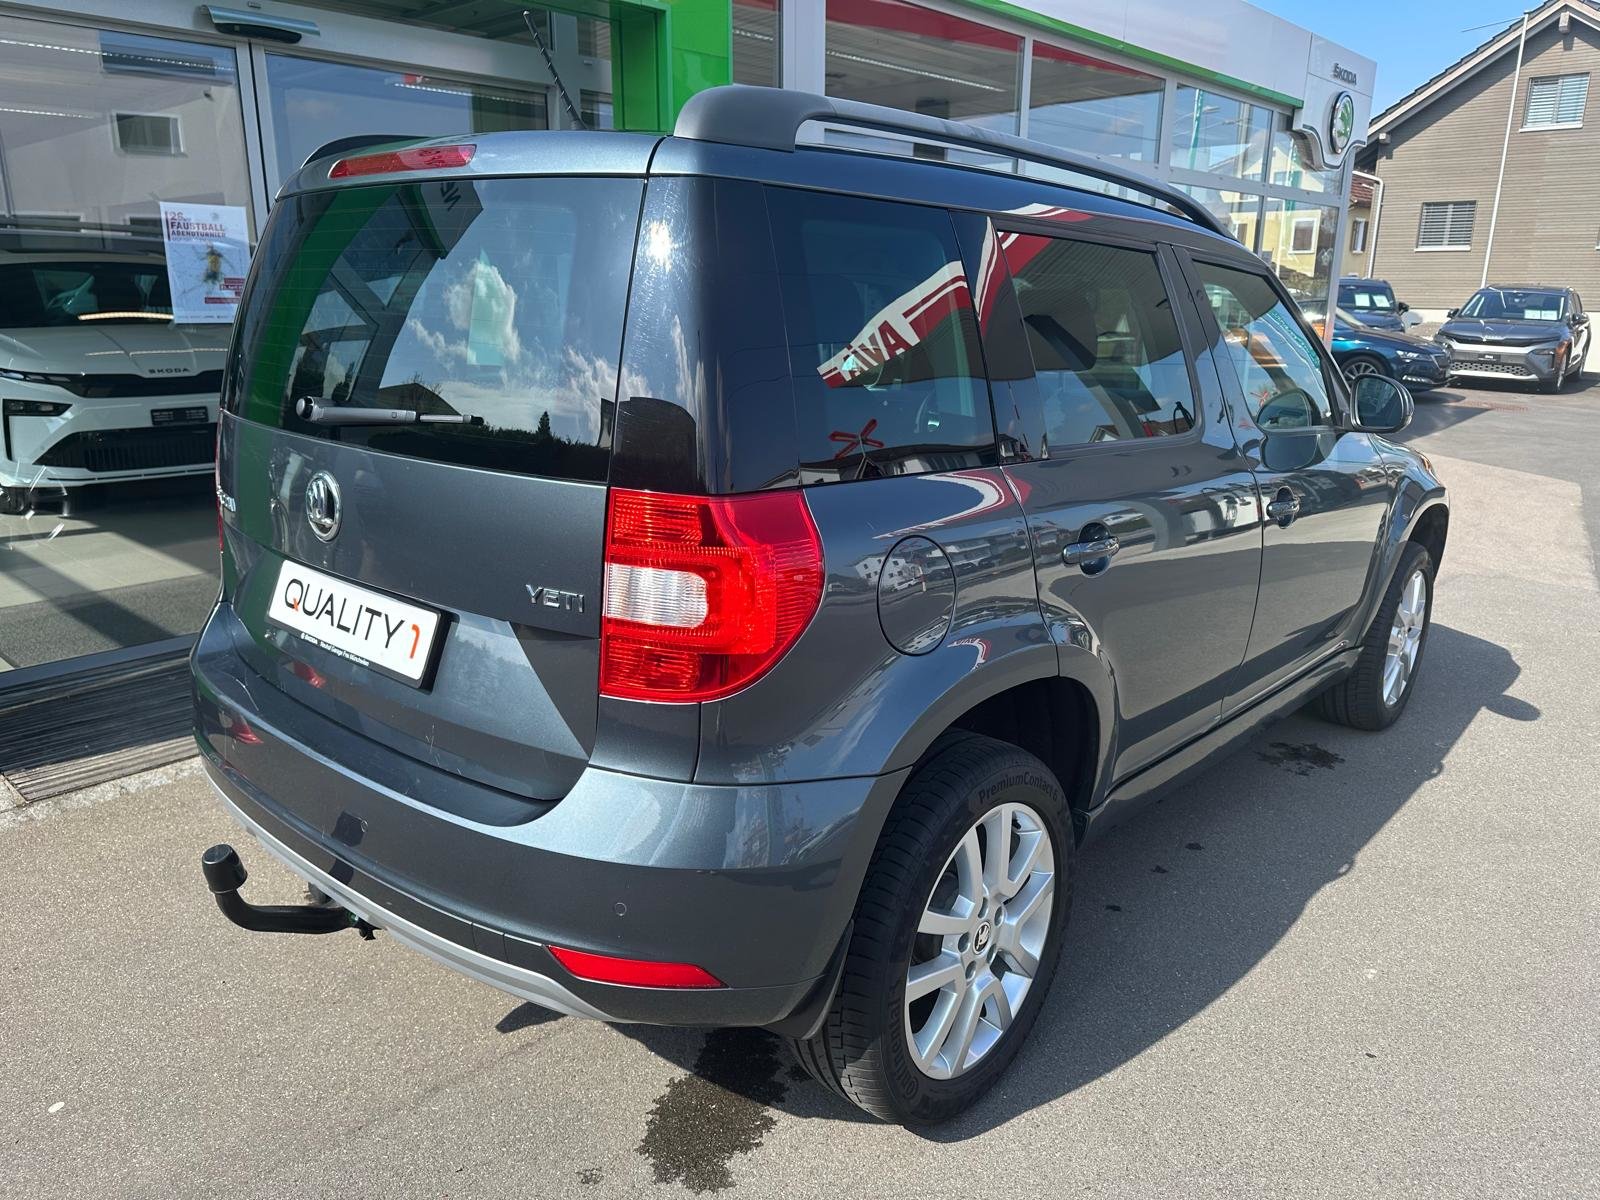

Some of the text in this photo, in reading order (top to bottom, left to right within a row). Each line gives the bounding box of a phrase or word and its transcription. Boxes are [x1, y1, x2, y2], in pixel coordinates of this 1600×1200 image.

[1333, 62, 1357, 86] ŠKODA
[170, 221, 225, 232] FAUSTBALL
[525, 584, 585, 613] YETI
[284, 578, 421, 660] QUALITY 1
